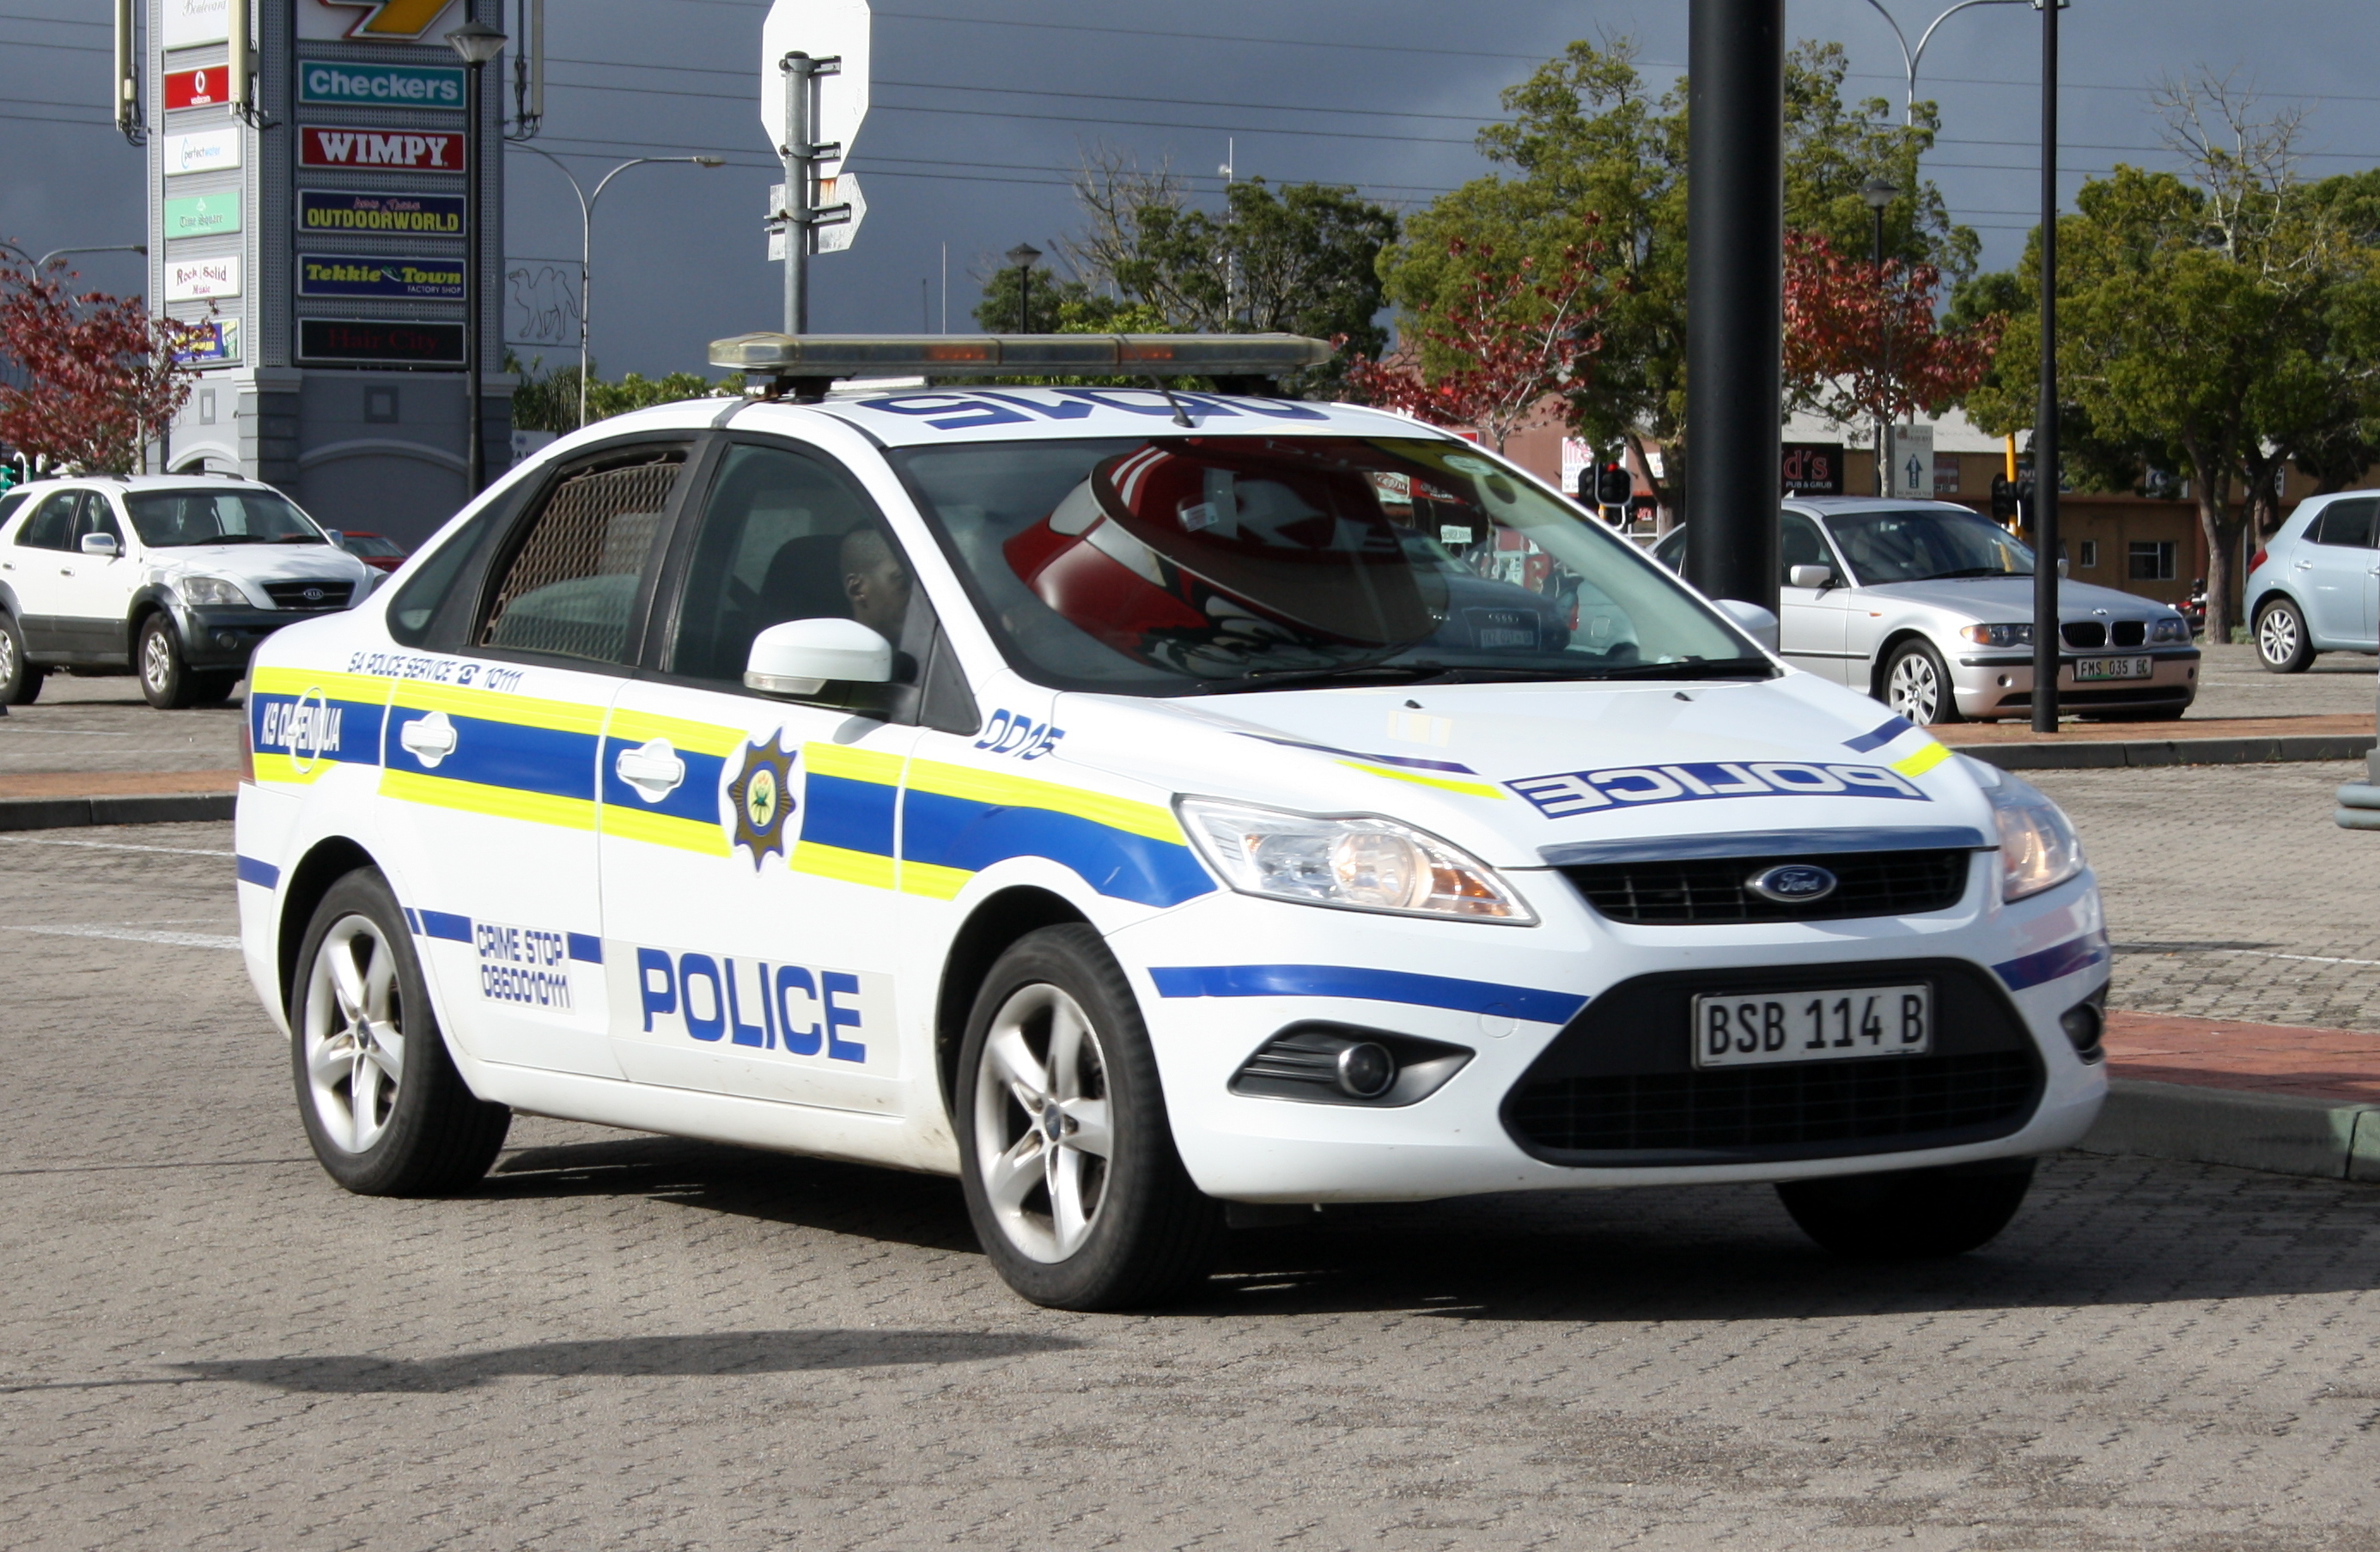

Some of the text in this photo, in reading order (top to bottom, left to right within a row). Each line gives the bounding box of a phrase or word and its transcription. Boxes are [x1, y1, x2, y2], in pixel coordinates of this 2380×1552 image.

[308, 69, 459, 100] Checkers
[317, 132, 448, 167] WIMPY
[307, 208, 460, 232] OUTDOORWORLD
[176, 265, 227, 286] Rock Solid
[306, 264, 462, 284] Tekkie Town
[407, 285, 440, 294] FACTORY
[327, 327, 440, 354] Hair City
[1780, 449, 1828, 480] d's
[347, 651, 523, 693] SA POLICE SERVICE 10111
[2080, 658, 2148, 677] FMS 035 EC
[260, 702, 280, 746] K9
[971, 708, 1066, 761] DD15
[1777, 871, 1820, 892] Ford
[477, 923, 563, 966] CRIME STOP
[481, 964, 570, 1009] 0860010111
[636, 946, 867, 1065] POLICE
[1708, 994, 1925, 1056] BSB 114 B
